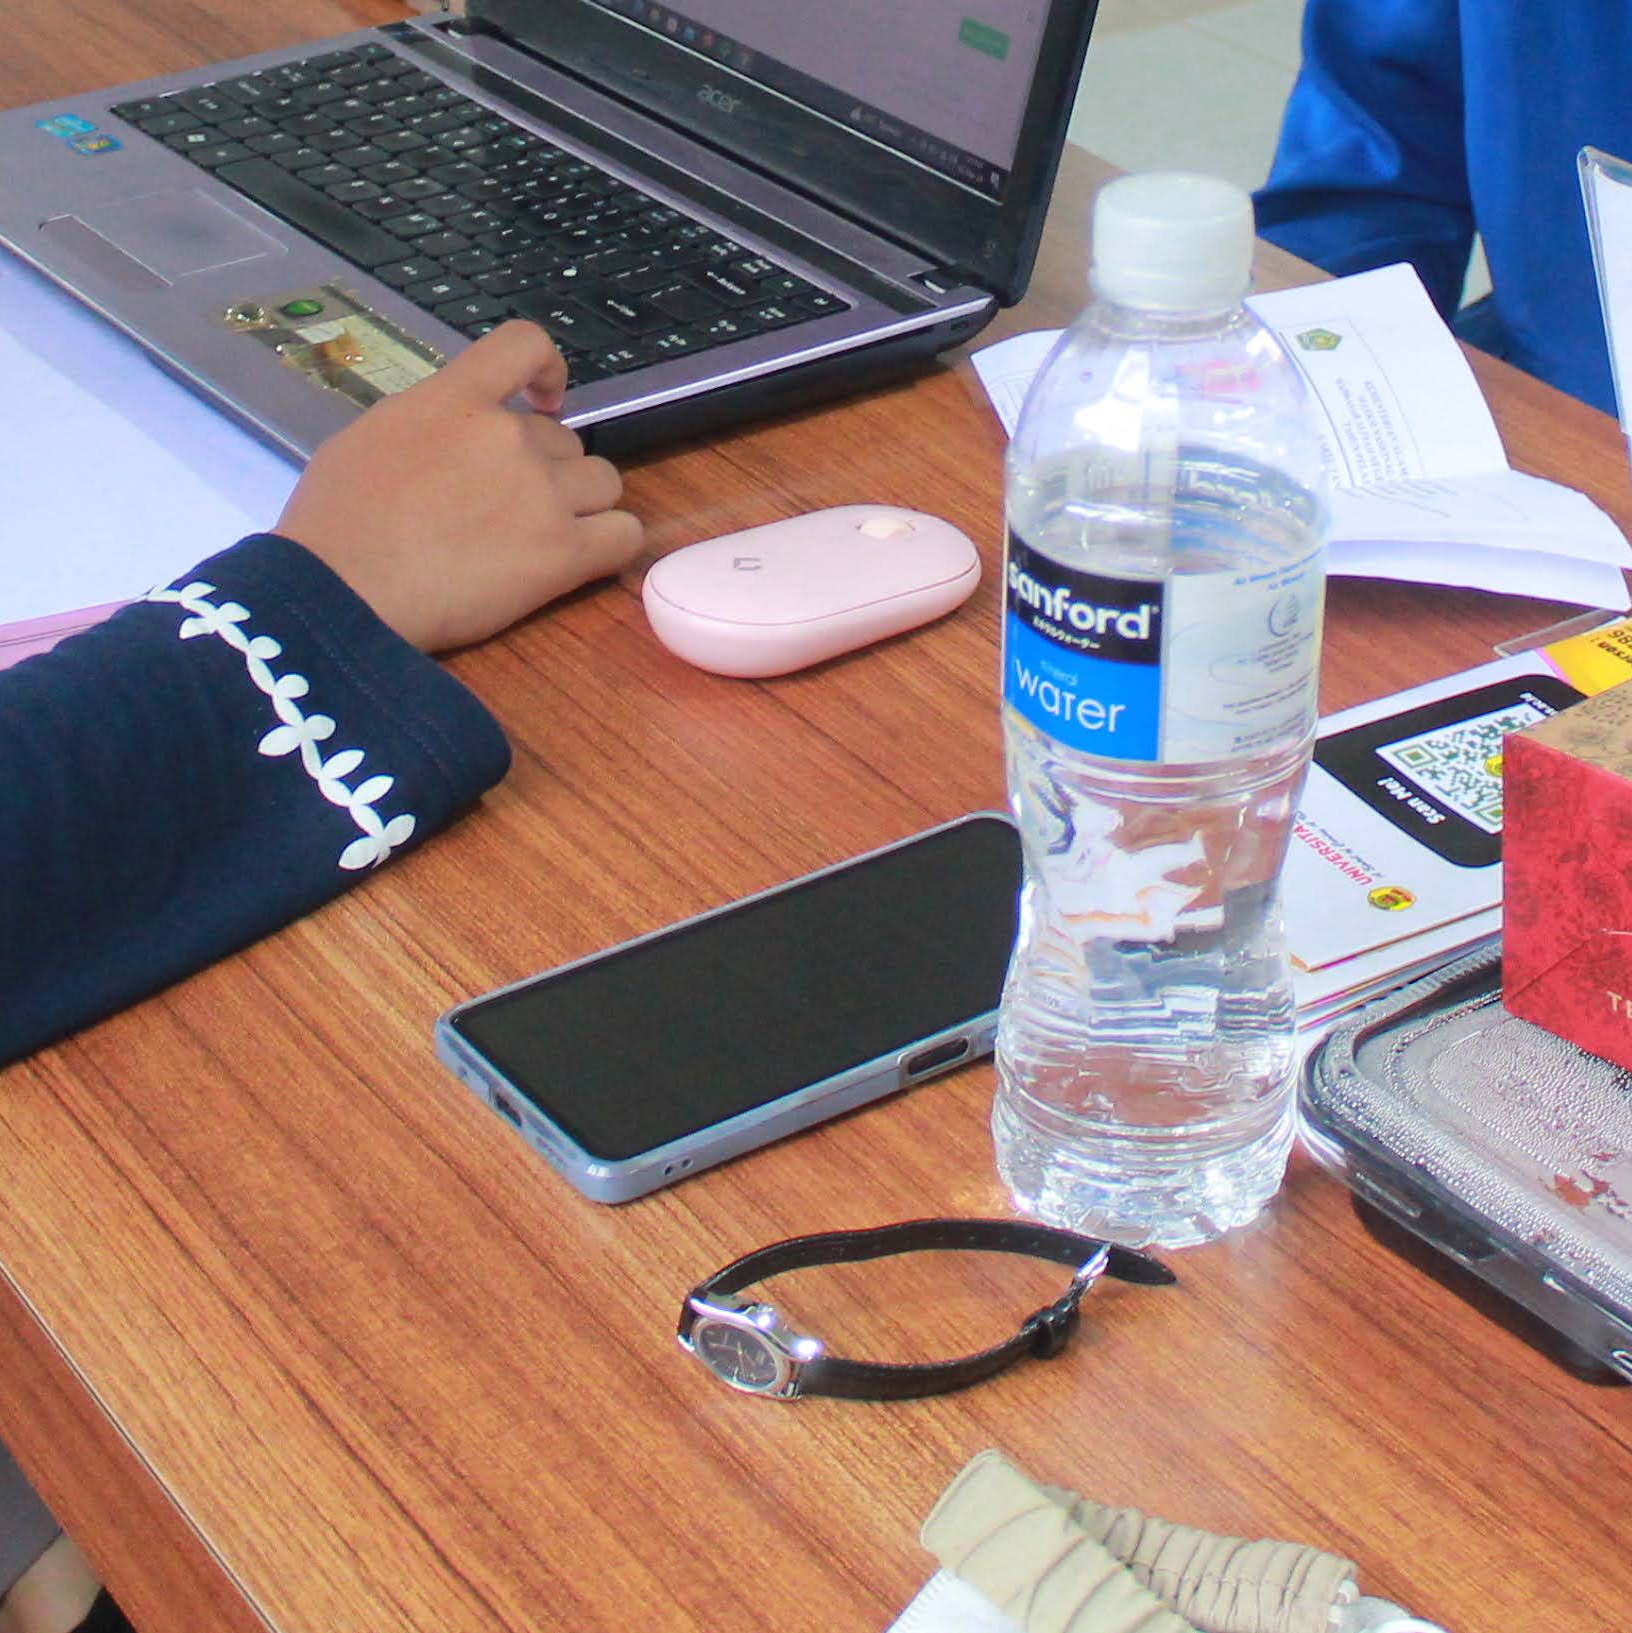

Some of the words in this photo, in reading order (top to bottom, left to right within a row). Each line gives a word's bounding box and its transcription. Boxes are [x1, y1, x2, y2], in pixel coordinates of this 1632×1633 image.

[697, 84, 742, 113] acer
[1015, 658, 1127, 734] water
[1376, 776, 1414, 801] Me!
[1407, 796, 1447, 825] Scan
[1293, 823, 1373, 886] UNIVERSITA
